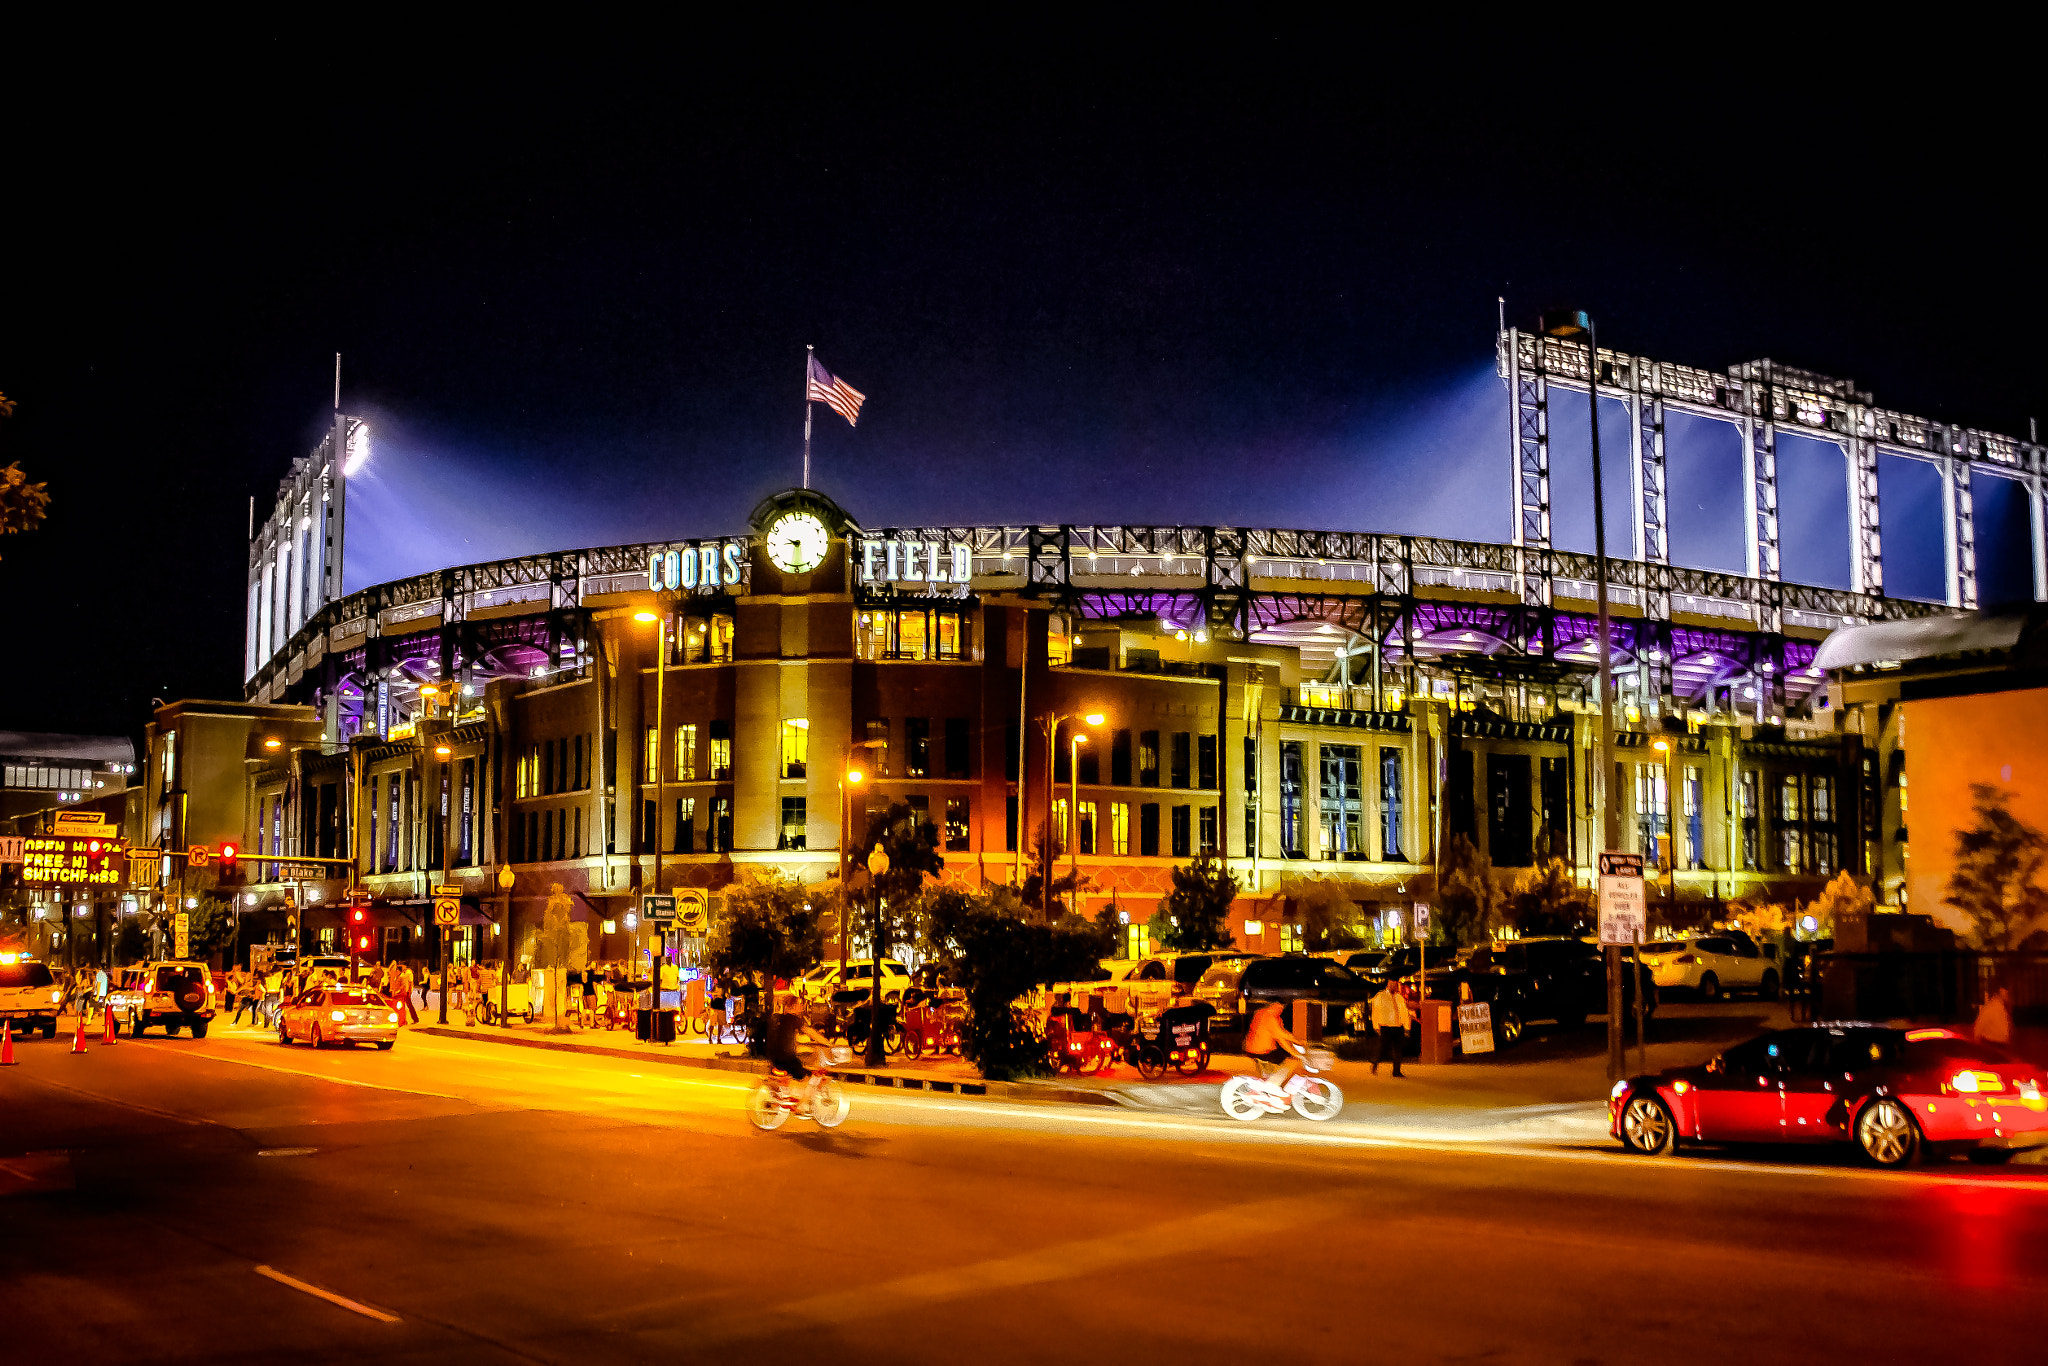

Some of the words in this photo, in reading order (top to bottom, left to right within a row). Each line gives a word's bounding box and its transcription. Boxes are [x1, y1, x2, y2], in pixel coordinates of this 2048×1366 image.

[649, 542, 741, 592] COORS
[862, 539, 973, 583] FIELD
[24, 853, 64, 867] FREE
[290, 867, 314, 877] Blake
